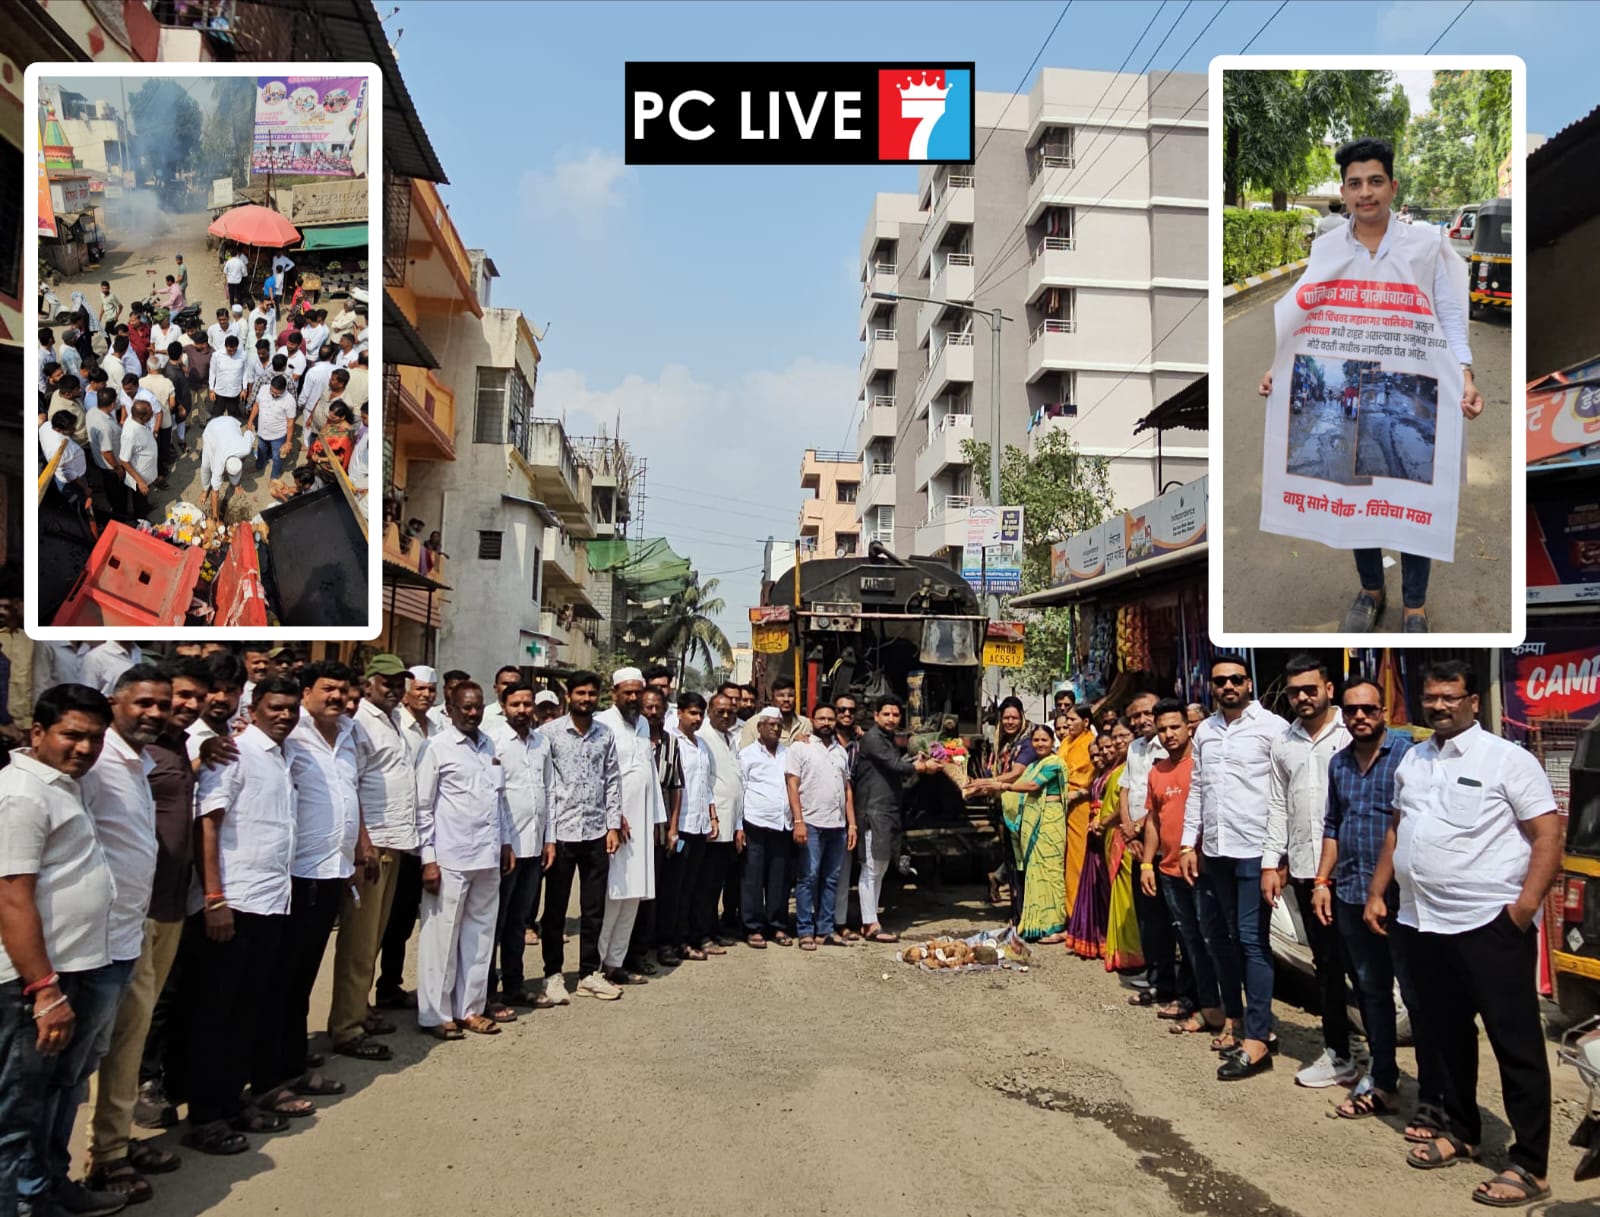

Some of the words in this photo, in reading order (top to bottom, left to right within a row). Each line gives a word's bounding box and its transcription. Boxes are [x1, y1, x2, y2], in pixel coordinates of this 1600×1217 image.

[1303, 286, 1337, 304] पालिका
[1339, 285, 1358, 302] आहे
[1360, 287, 1414, 306] ग्रामपंचायत
[1415, 320, 1434, 335] असून
[1403, 333, 1426, 346] अनुभव
[1361, 344, 1392, 356] नागरिक
[1283, 491, 1306, 513] वाघू
[1307, 494, 1329, 512] साने
[1331, 498, 1356, 518] चौक
[1366, 498, 1404, 519] चिंचेचा
[1406, 507, 1432, 526] मळा
[989, 654, 1021, 665] AC5512
